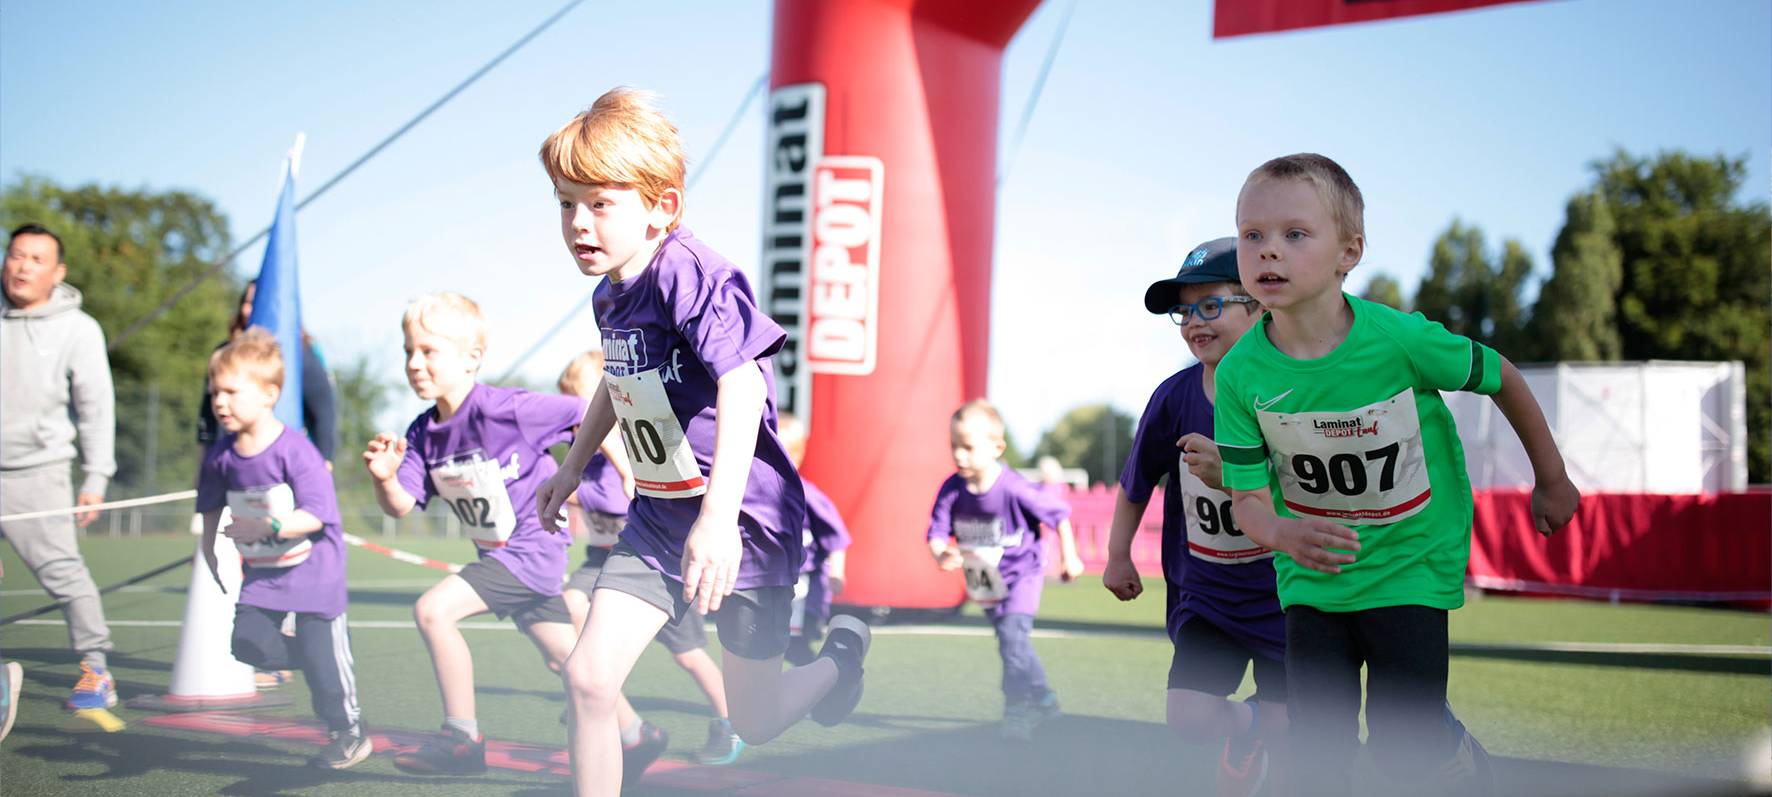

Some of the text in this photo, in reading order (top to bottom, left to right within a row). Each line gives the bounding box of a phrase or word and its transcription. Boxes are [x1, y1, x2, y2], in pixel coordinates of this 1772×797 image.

[769, 96, 809, 413] Laminat
[809, 169, 872, 361] DEPOT
[622, 417, 667, 465] 10
[1313, 417, 1361, 429] Laminat
[1324, 428, 1353, 437] DEPOT
[1291, 441, 1400, 497] 907
[1196, 495, 1245, 537] 90
